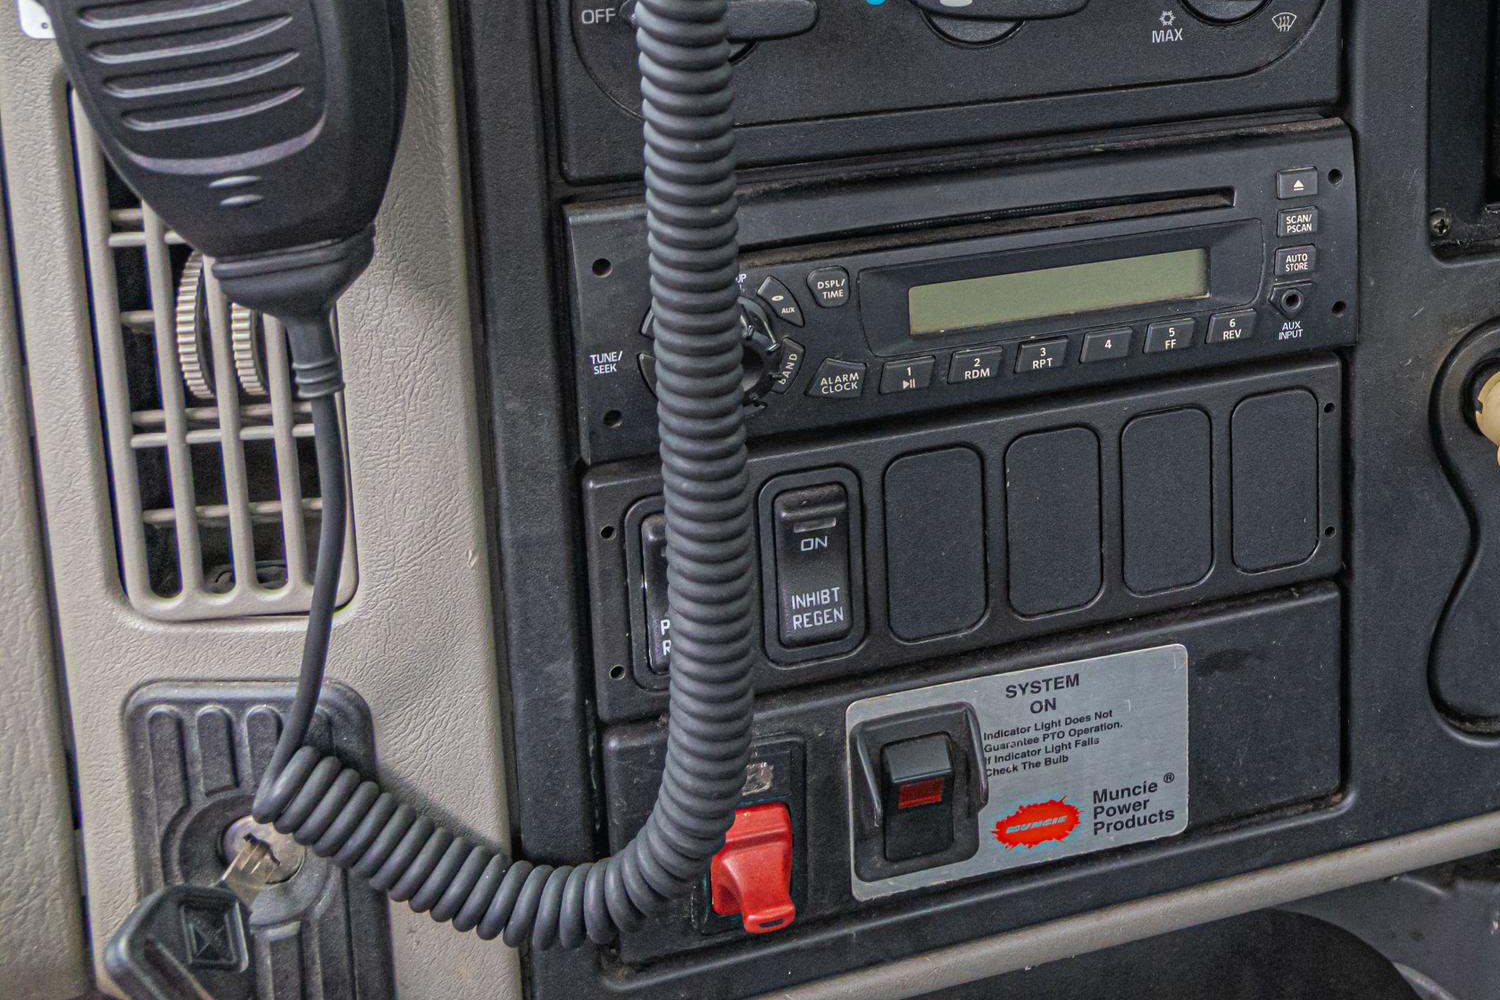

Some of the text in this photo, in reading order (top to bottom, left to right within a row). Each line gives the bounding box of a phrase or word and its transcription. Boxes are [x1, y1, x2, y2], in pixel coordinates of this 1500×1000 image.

[581, 7, 616, 25] OFF
[1152, 28, 1183, 43] MAX
[1286, 213, 1312, 225] SCAN/
[1286, 223, 1312, 234] PSCAN
[1285, 252, 1308, 263] AUTO
[1285, 261, 1309, 272] STORE
[817, 278, 846, 290] DSPL/
[822, 289, 844, 300] TIME
[781, 306, 796, 314] AUX
[1229, 318, 1237, 329] 6
[1281, 320, 1302, 332] AUX
[1168, 327, 1176, 338] 5
[1222, 328, 1242, 341] REV
[1278, 328, 1304, 340] INPUT
[1104, 338, 1112, 350] 4
[1164, 338, 1177, 350] FF
[589, 350, 624, 365] TUNE/
[1039, 346, 1047, 357] 3
[593, 363, 617, 375] SEEK
[973, 358, 981, 368] 2
[1031, 357, 1054, 370] RPT
[906, 366, 912, 376] 1
[964, 367, 991, 380] RDM
[820, 372, 860, 386] ALARM
[821, 382, 859, 394] CLOCK
[801, 535, 828, 552] ON
[792, 587, 841, 610] INHIBT
[793, 606, 844, 630] REGEN
[1005, 673, 1080, 699] SYSTEM
[1030, 698, 1057, 714] ON
[984, 709, 1113, 741] Indicator Light Does Not
[984, 721, 1123, 753] Guarantee PTO Operation.
[995, 748, 1041, 763] Indicator
[1044, 742, 1072, 755] Light
[1075, 737, 1100, 749] Fails
[985, 754, 1069, 778] Check The Bulb
[1093, 780, 1158, 804] Muncie
[1093, 798, 1150, 820] Power
[1093, 809, 1175, 836] Products
